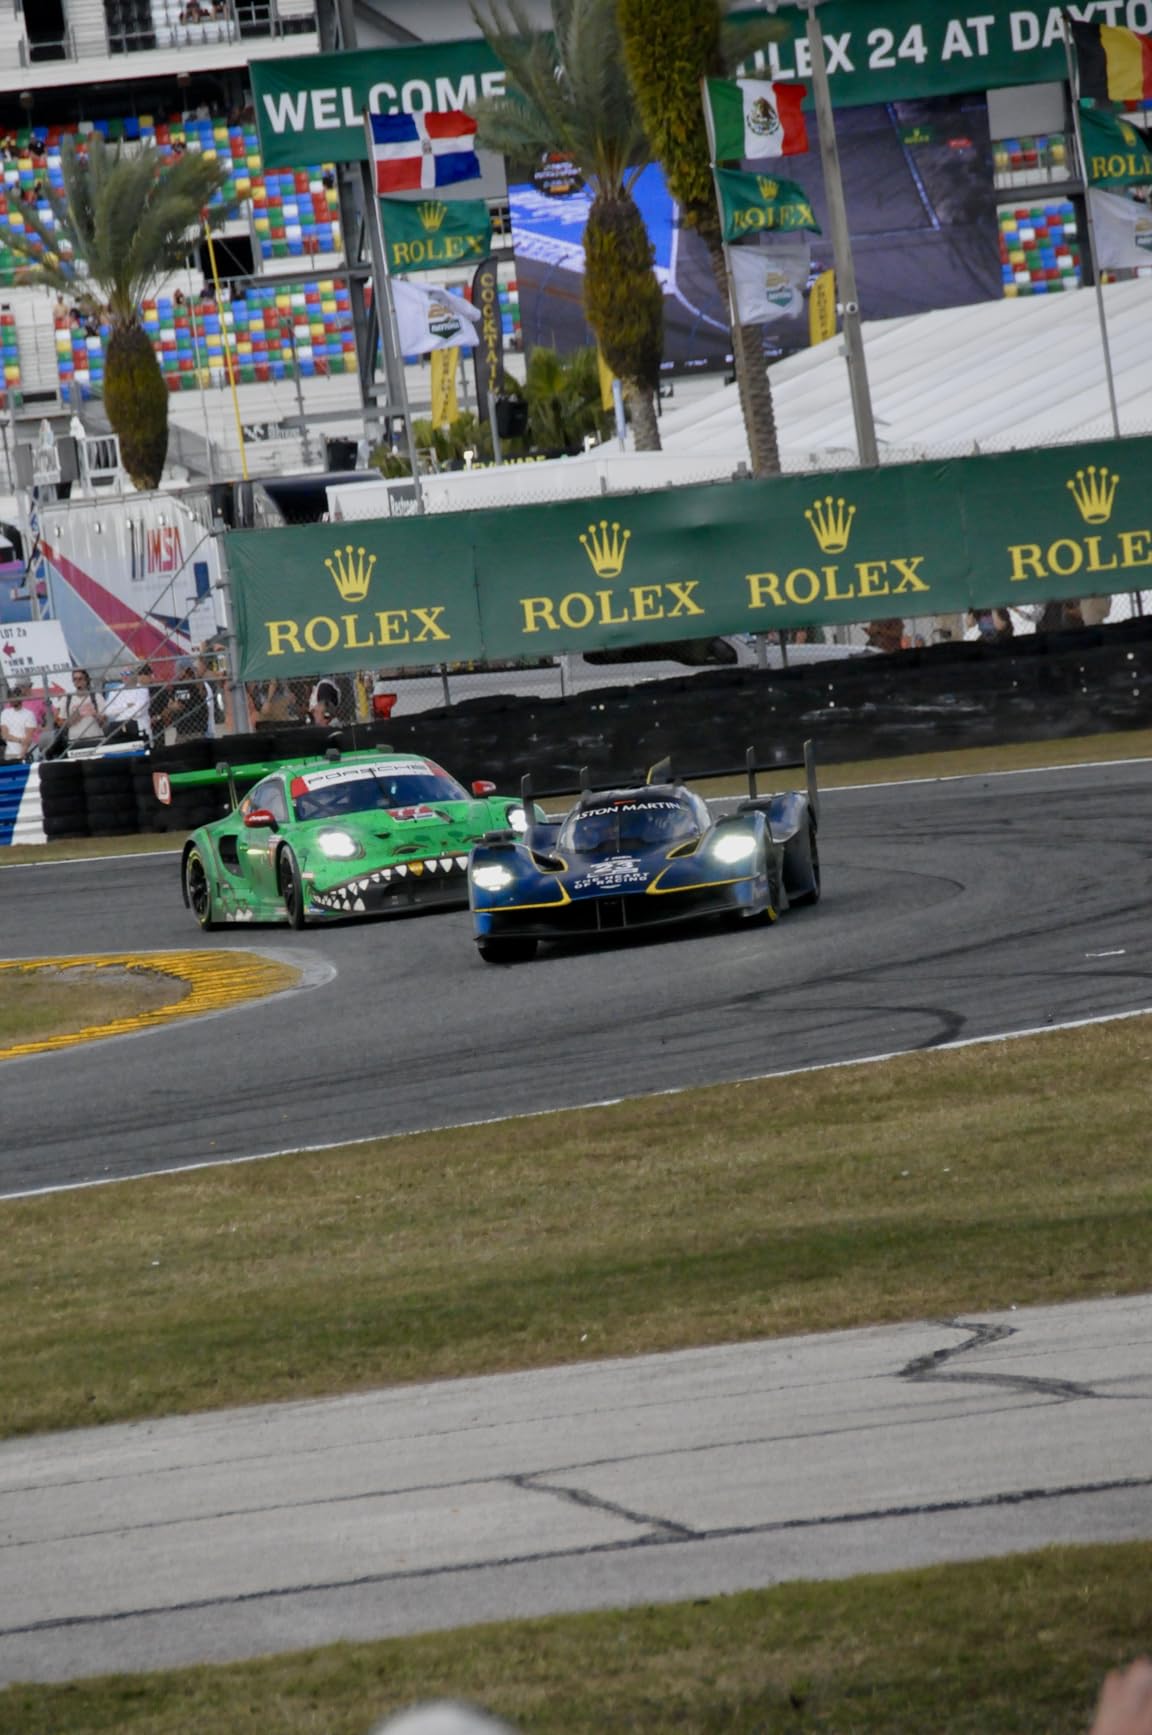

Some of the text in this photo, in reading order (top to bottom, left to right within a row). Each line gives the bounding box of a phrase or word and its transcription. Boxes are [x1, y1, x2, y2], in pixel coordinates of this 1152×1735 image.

[867, 24, 928, 70] 24
[941, 15, 995, 61] AT
[263, 71, 507, 134] WELCOME
[733, 203, 816, 232] ROLEX
[392, 235, 485, 266] ROLEX
[1008, 530, 1152, 582] ROLE
[520, 580, 706, 634] ROLEX
[746, 556, 931, 609] ROLEX
[264, 606, 452, 657] ROLEX
[622, 802, 681, 813] MARTIN
